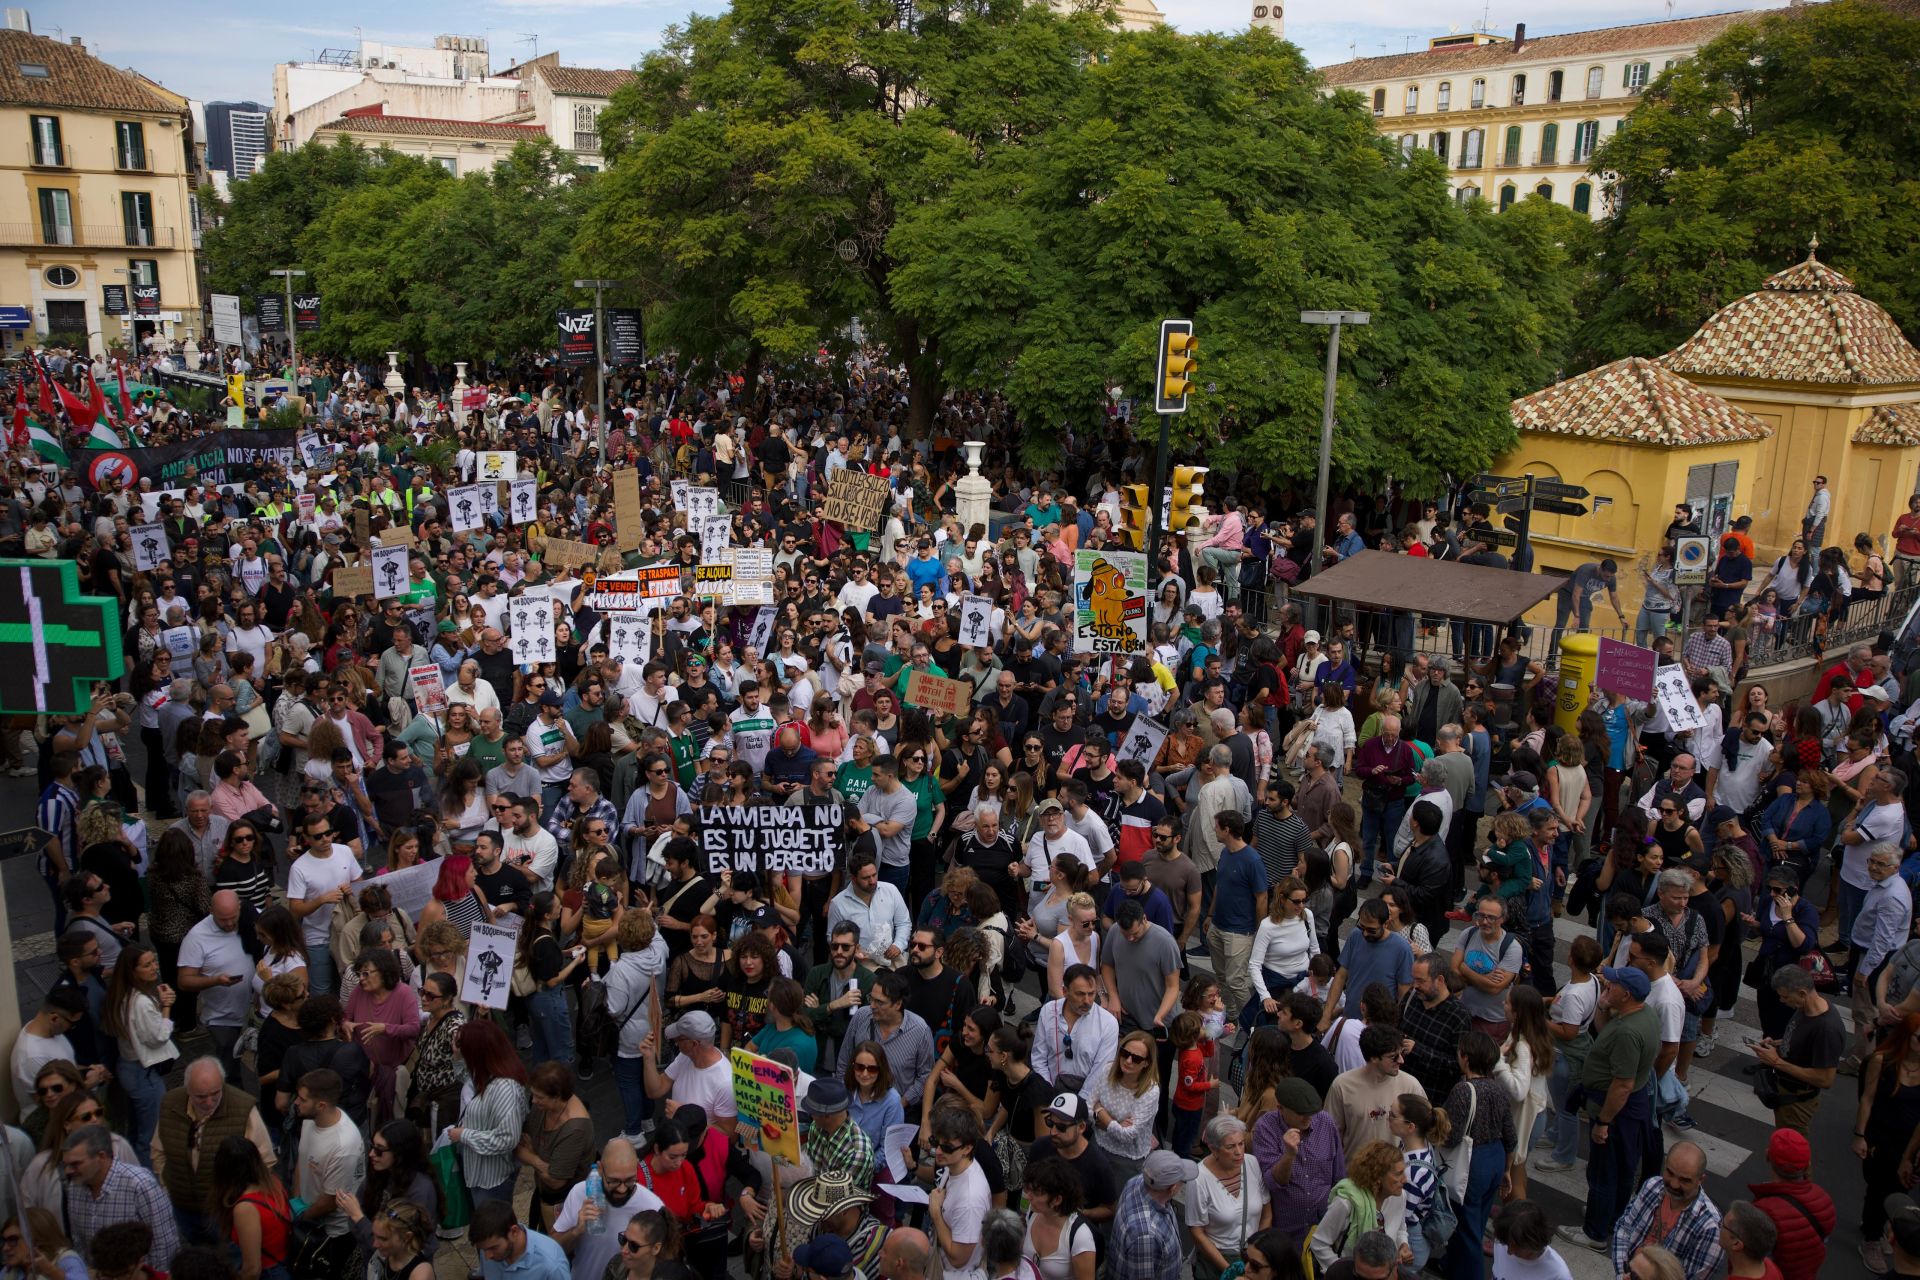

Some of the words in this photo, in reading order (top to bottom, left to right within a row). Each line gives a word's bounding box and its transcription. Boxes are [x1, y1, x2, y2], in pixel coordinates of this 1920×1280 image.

[134, 287, 158, 298] JAZZ
[294, 297, 320, 309] JAZZ
[558, 314, 594, 333] JAZZ
[228, 448, 242, 463] NO
[827, 500, 840, 518] NO
[639, 570, 647, 580] SE
[648, 567, 678, 579] TRASPASA
[697, 568, 705, 578] SE
[706, 567, 730, 580] ALQUILA
[597, 582, 607, 591] SE
[609, 582, 637, 591] VENDE
[521, 595, 549, 605] BOQUERONES
[621, 615, 649, 625] BOQUERONES
[1078, 622, 1113, 638] ESTO
[1116, 624, 1133, 638] NO
[918, 686, 941, 697] VOTEN
[915, 695, 929, 704] LOS
[681, 746, 686, 758] 7
[847, 779, 867, 788] PAH
[699, 805, 725, 825] LA
[726, 805, 805, 828] VIVIENDA
[815, 804, 842, 827] NO
[703, 829, 728, 850] ES
[731, 829, 754, 849] TU
[760, 828, 842, 850] JUGUETE,
[709, 852, 730, 873] ES
[735, 852, 756, 872] UN
[765, 848, 835, 872] DERECHO
[473, 925, 481, 933] SIN
[482, 925, 516, 940] BOQUERONES
[732, 1056, 785, 1084] VIVIENDA
[735, 1074, 762, 1092] PARA
[770, 1091, 791, 1108] LOS
[736, 1090, 793, 1123] MIGRANTES
